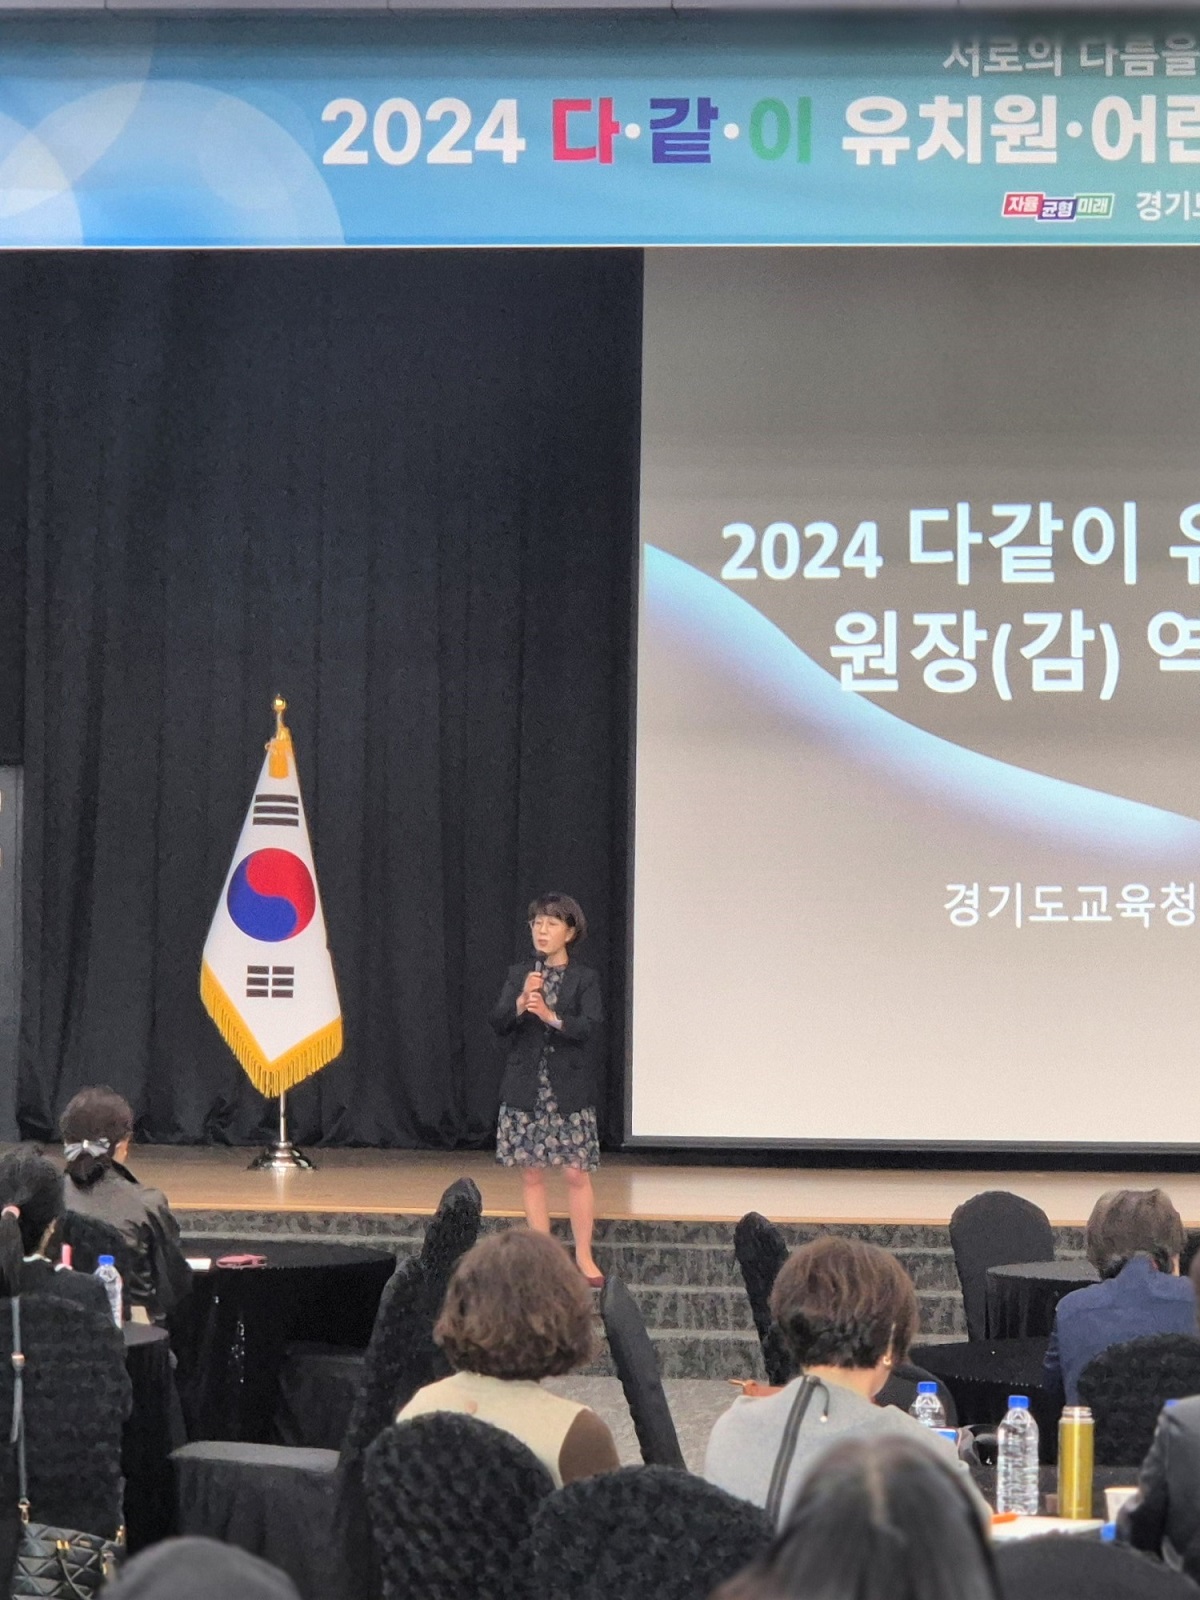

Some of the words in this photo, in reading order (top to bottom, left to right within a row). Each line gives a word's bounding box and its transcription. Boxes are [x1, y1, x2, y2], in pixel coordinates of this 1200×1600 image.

[942, 34, 1063, 77] 서로의
[1080, 35, 1200, 77] 다름을
[321, 97, 525, 166] 2024
[1079, 198, 1108, 213] 미래
[720, 520, 884, 581] 2024
[909, 501, 1137, 586] 다같이
[830, 609, 1120, 701] 원장(감)
[943, 881, 1198, 928] 경기도교육청
